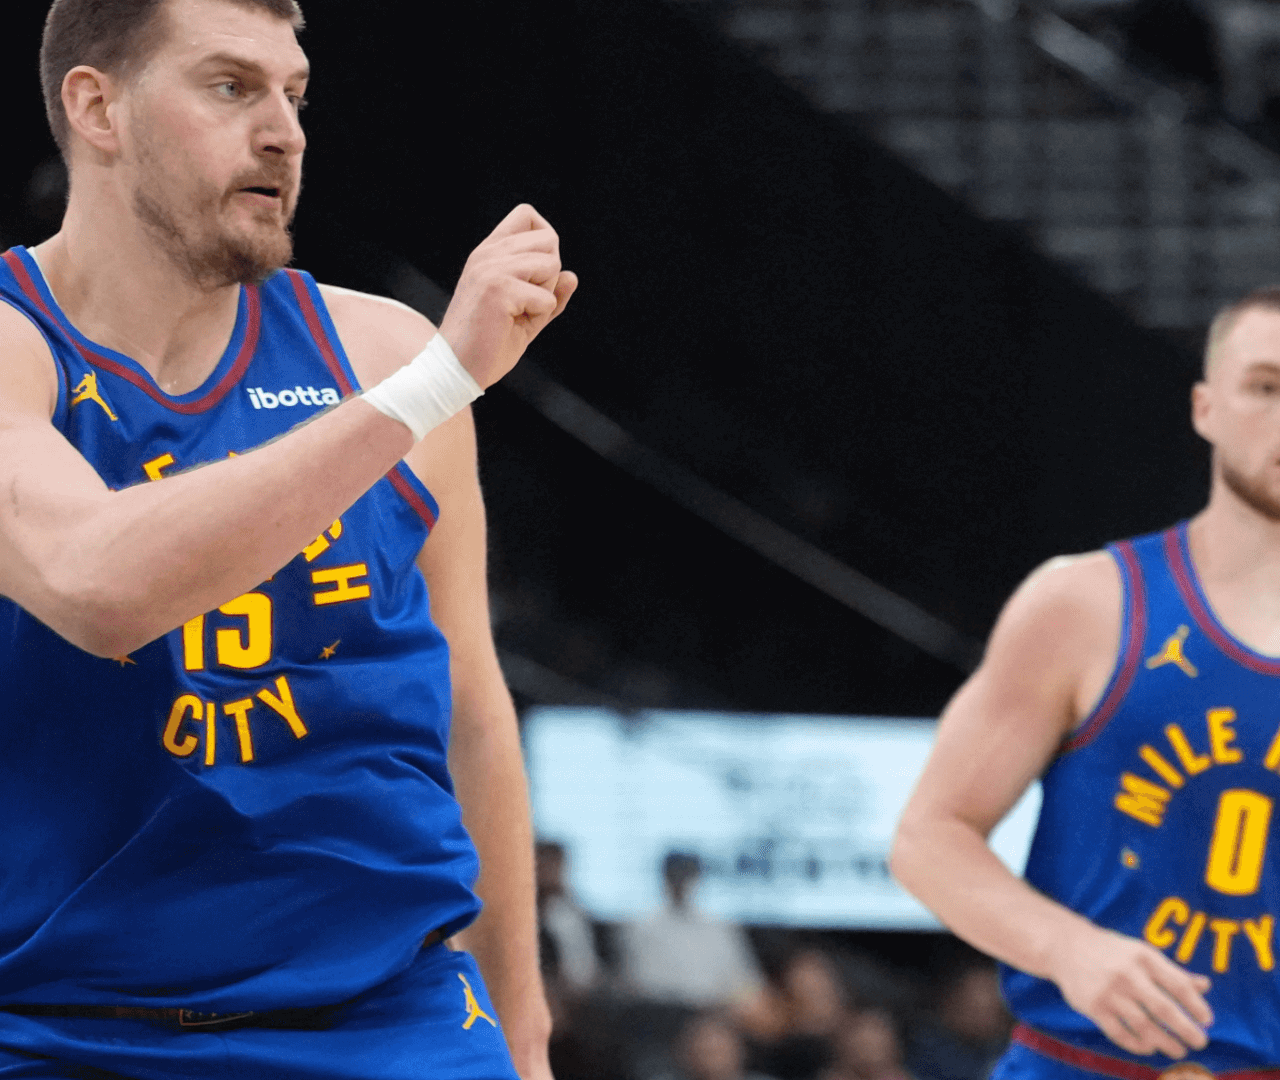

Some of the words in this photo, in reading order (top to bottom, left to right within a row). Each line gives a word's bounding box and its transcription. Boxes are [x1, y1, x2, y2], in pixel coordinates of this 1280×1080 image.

[246, 385, 341, 410] ibotta
[162, 675, 309, 766] CITY
[1113, 706, 1244, 828] MILE
[1204, 787, 1274, 896] 0
[1143, 896, 1275, 974] CITY
